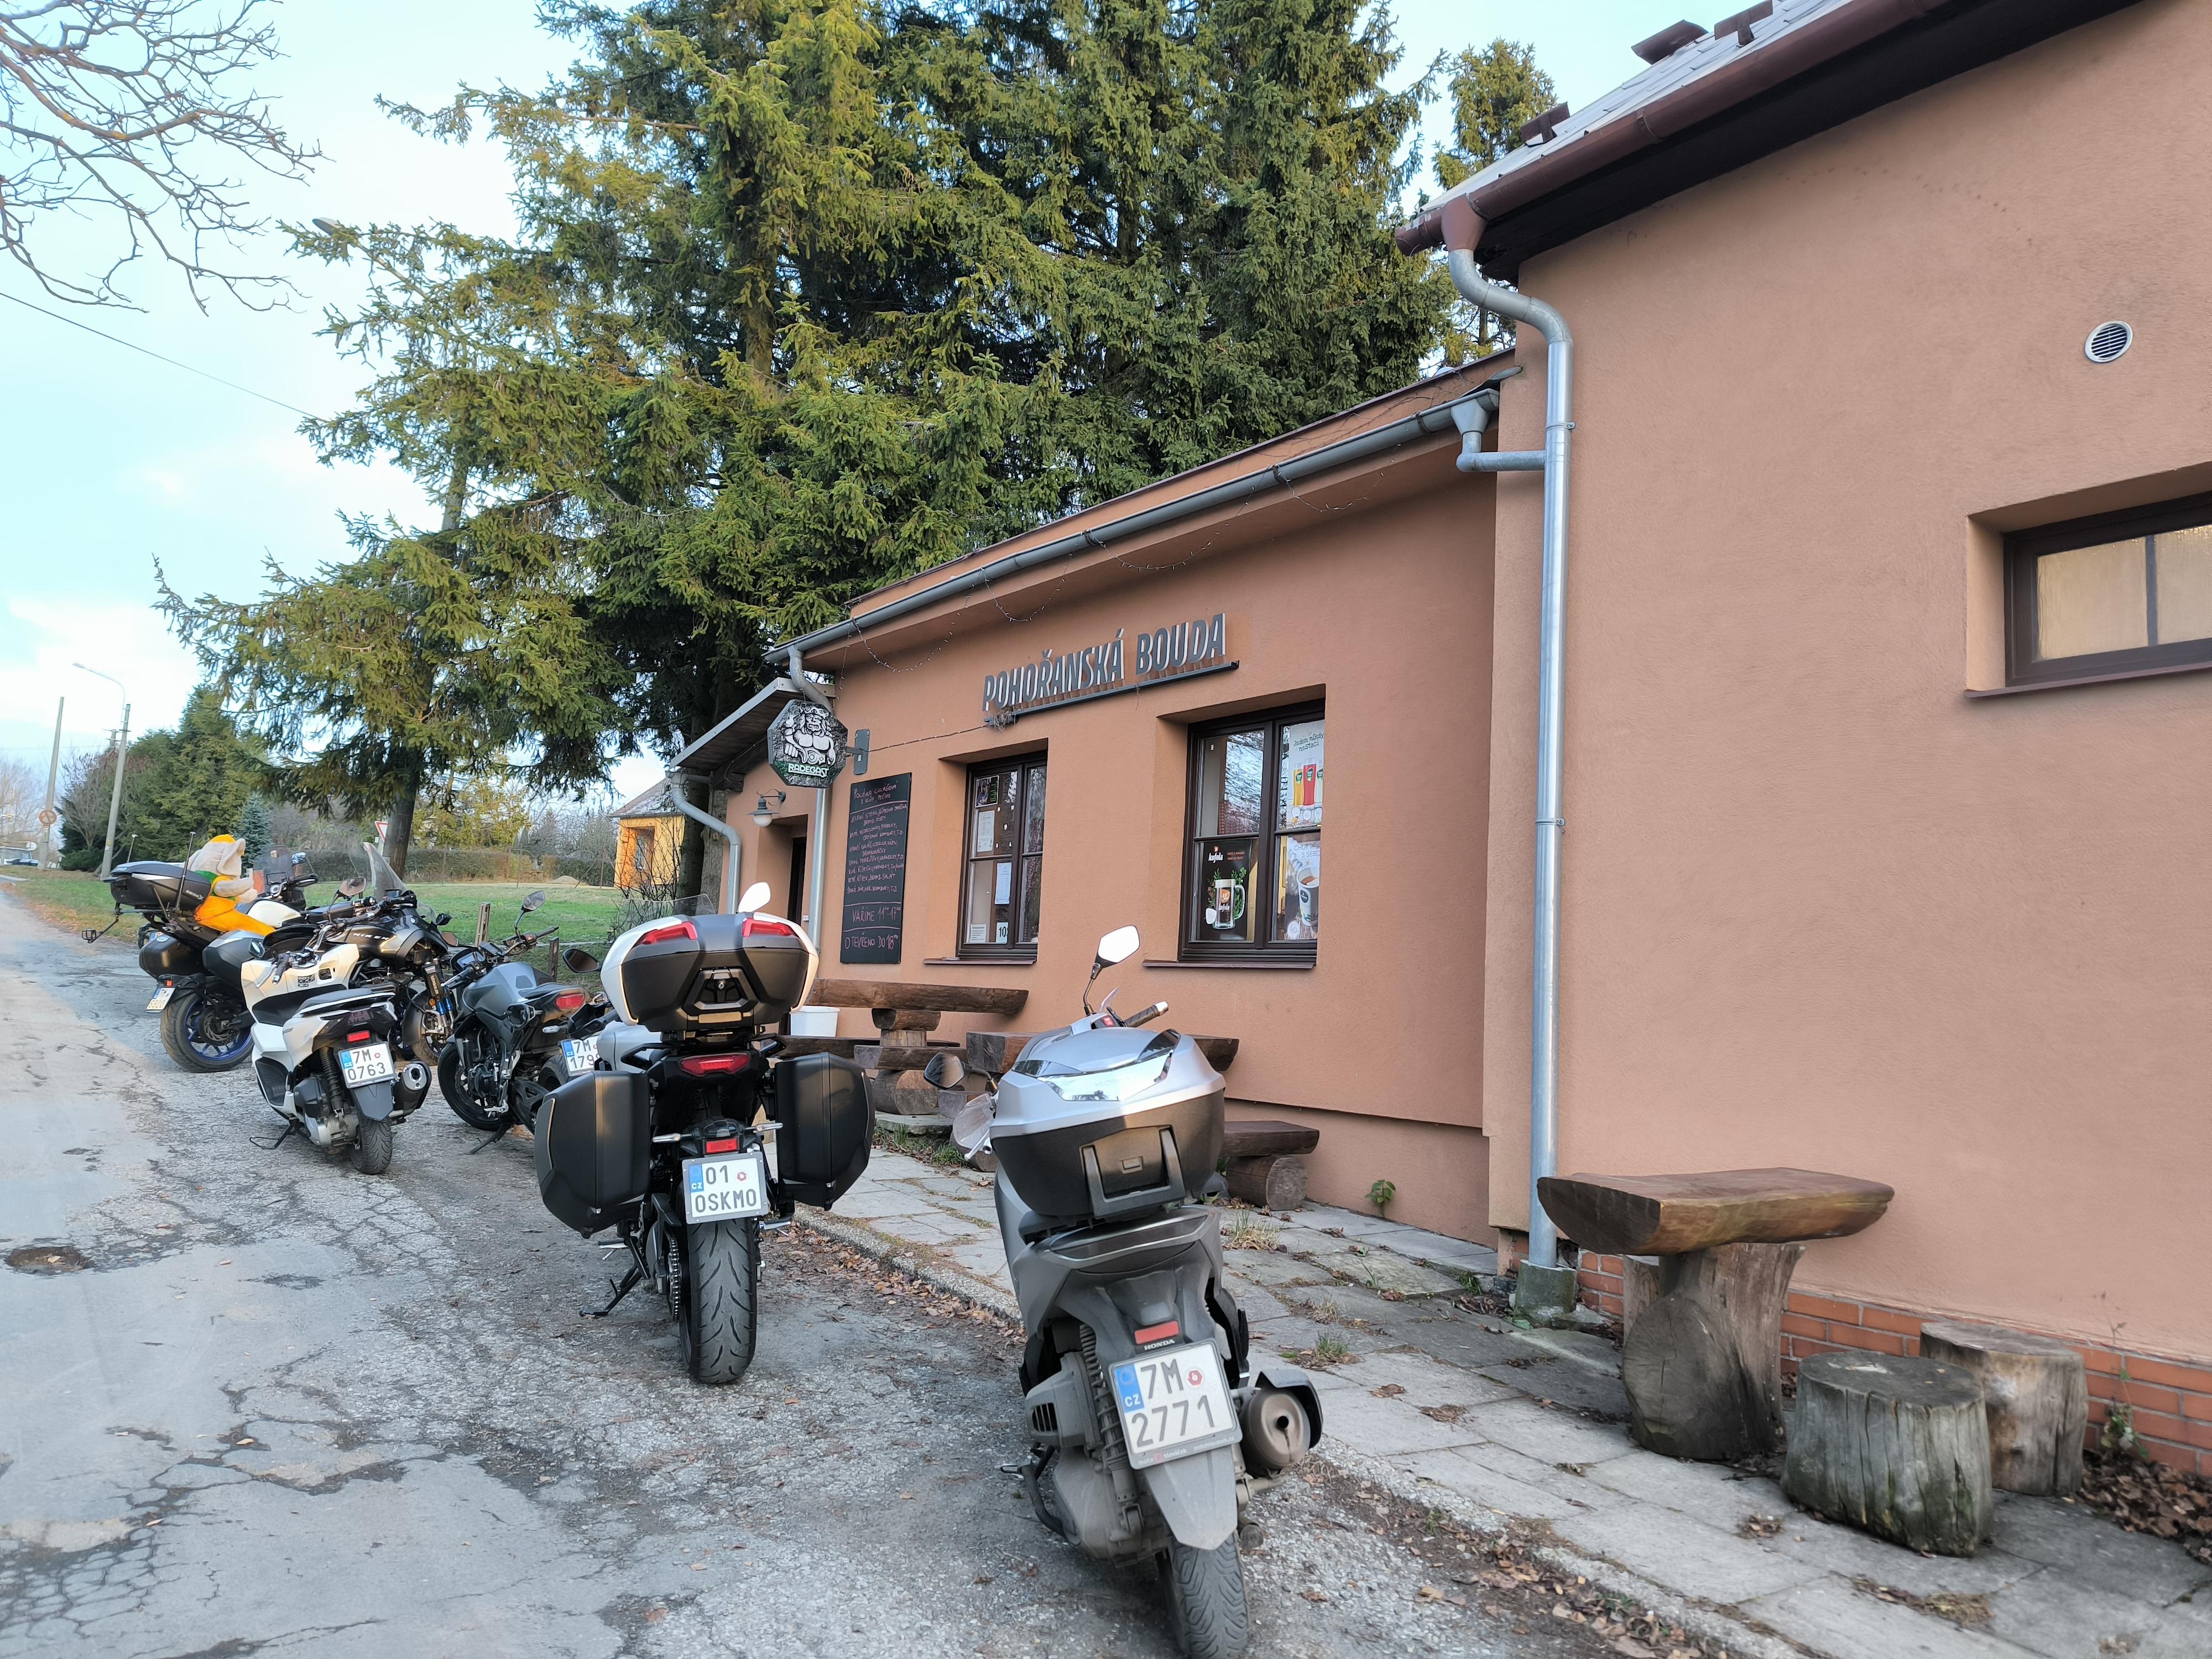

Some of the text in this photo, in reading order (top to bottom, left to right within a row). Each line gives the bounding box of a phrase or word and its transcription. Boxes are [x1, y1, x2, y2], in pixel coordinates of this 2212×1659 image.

[982, 612, 1226, 712] POHOŘANSKÁ BOUDA
[788, 763, 830, 778] RADEGAST
[1208, 852, 1223, 863] kofola
[852, 906, 875, 922] VAŘÍME
[1218, 903, 1230, 912] kofola
[844, 931, 875, 950] OTEVŘENO
[877, 935, 885, 948] DO
[573, 1040, 591, 1053] 7M
[352, 1049, 372, 1064] 7M
[347, 1062, 385, 1081] 0763
[706, 1165, 729, 1185] 01
[1144, 1339, 1175, 1350] HONDA
[1141, 1359, 1184, 1399] 7M
[1124, 1394, 1141, 1407] CZ
[1131, 1395, 1215, 1448] 2771
